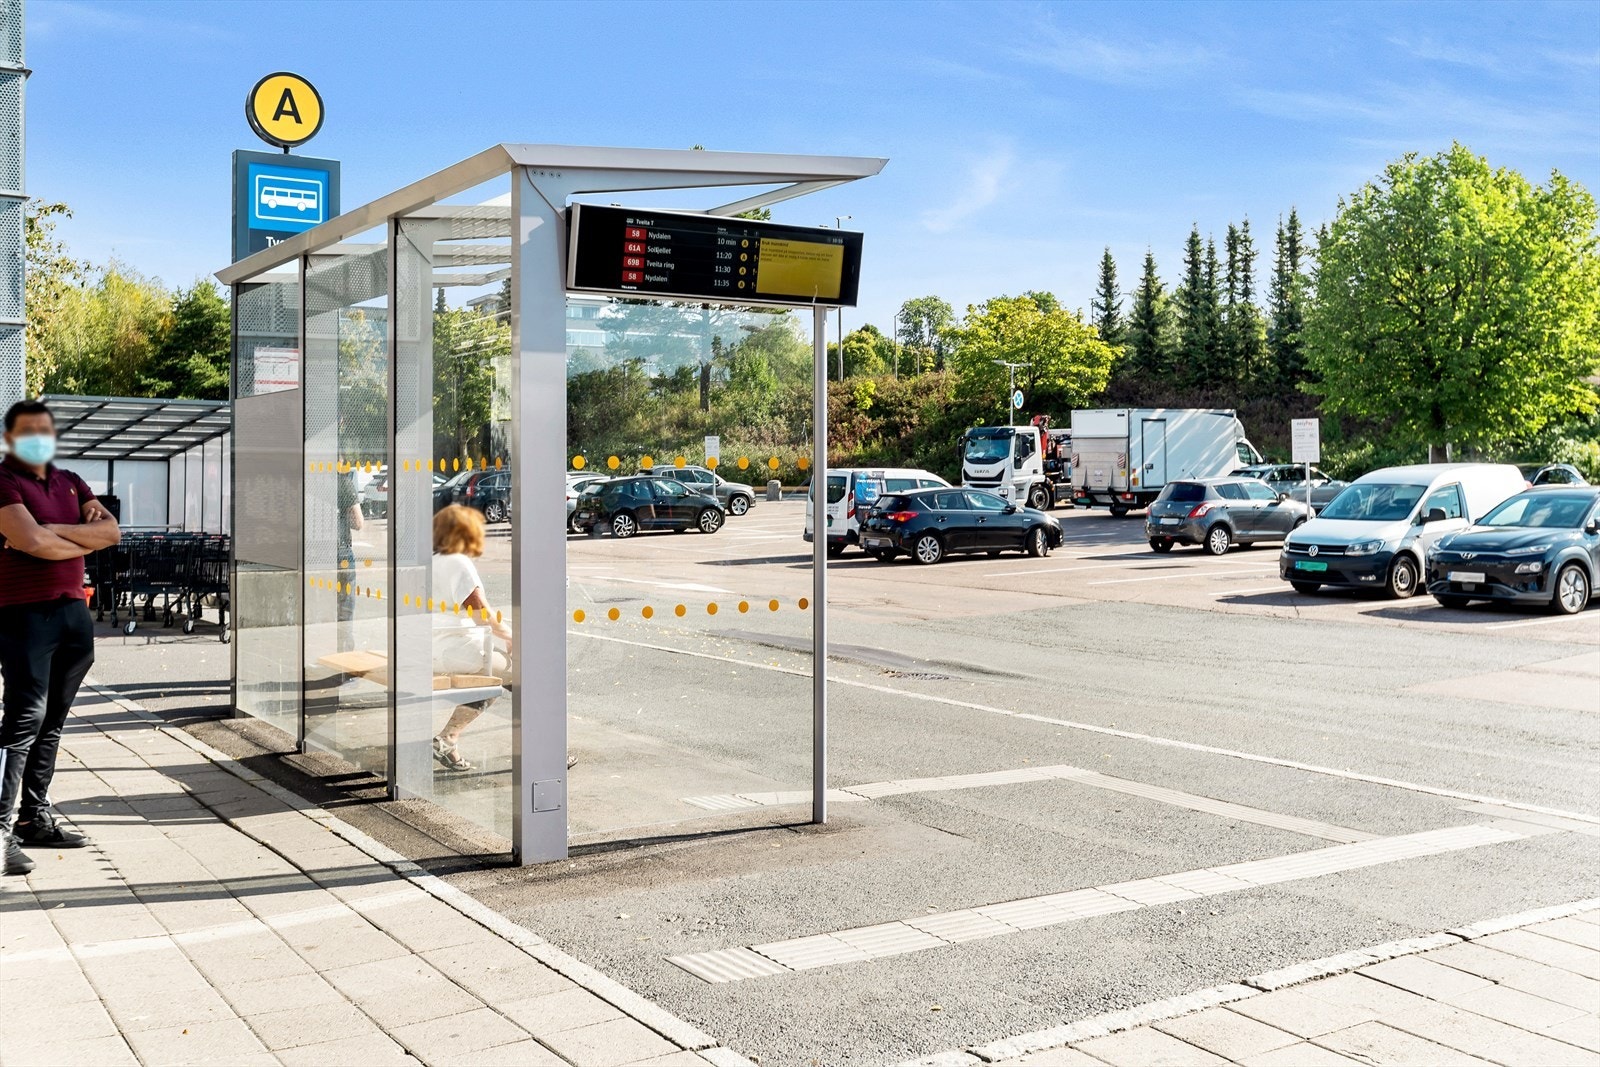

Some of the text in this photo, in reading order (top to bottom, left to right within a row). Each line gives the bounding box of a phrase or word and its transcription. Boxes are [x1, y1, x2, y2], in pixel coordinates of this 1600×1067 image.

[272, 88, 303, 125] A
[648, 232, 671, 240] Nydalen
[628, 244, 641, 252] 61A
[716, 251, 732, 259] 11:20
[627, 258, 640, 266] 69B
[664, 262, 675, 270] ring
[715, 265, 731, 273] 11:30
[628, 272, 637, 280] 58
[645, 274, 668, 282] Nydalen
[714, 279, 730, 287] 11:35
